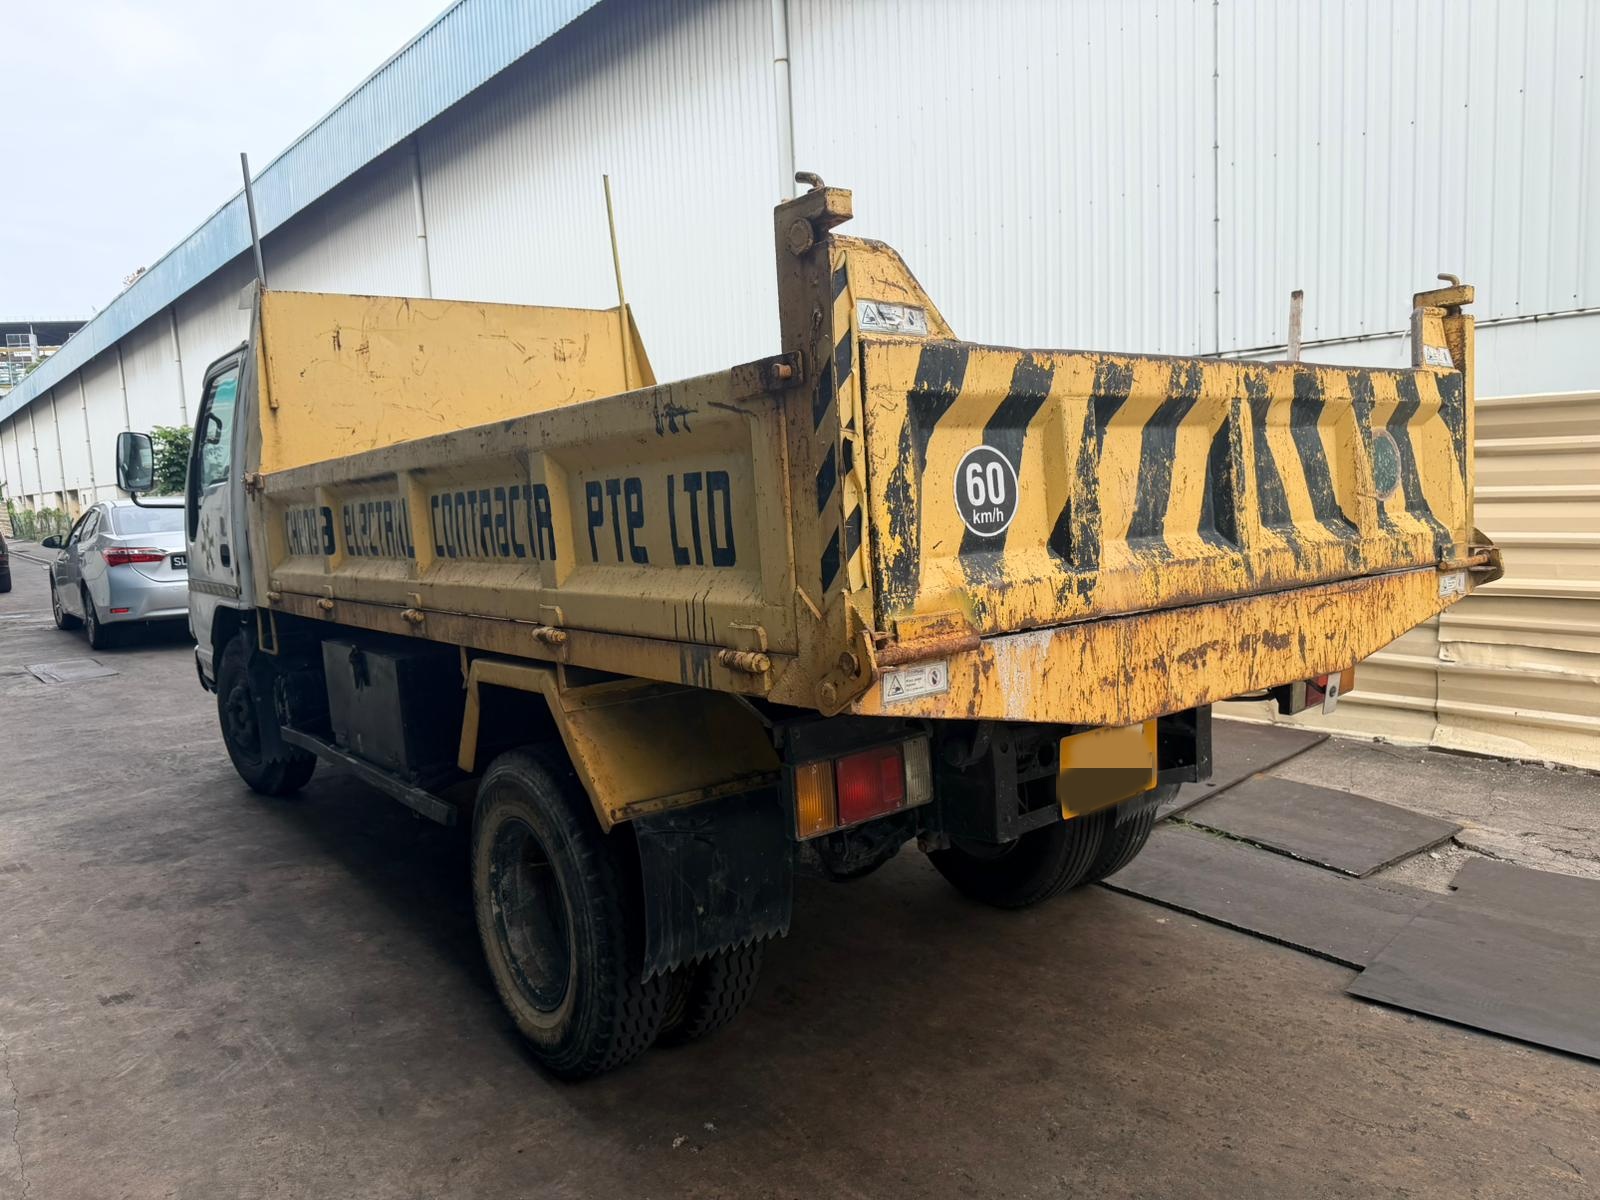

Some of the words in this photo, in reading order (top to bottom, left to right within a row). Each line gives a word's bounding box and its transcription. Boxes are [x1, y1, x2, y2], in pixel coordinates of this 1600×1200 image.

[966, 461, 1006, 507] 60
[667, 470, 736, 567] LTD
[973, 507, 1004, 524] km/h
